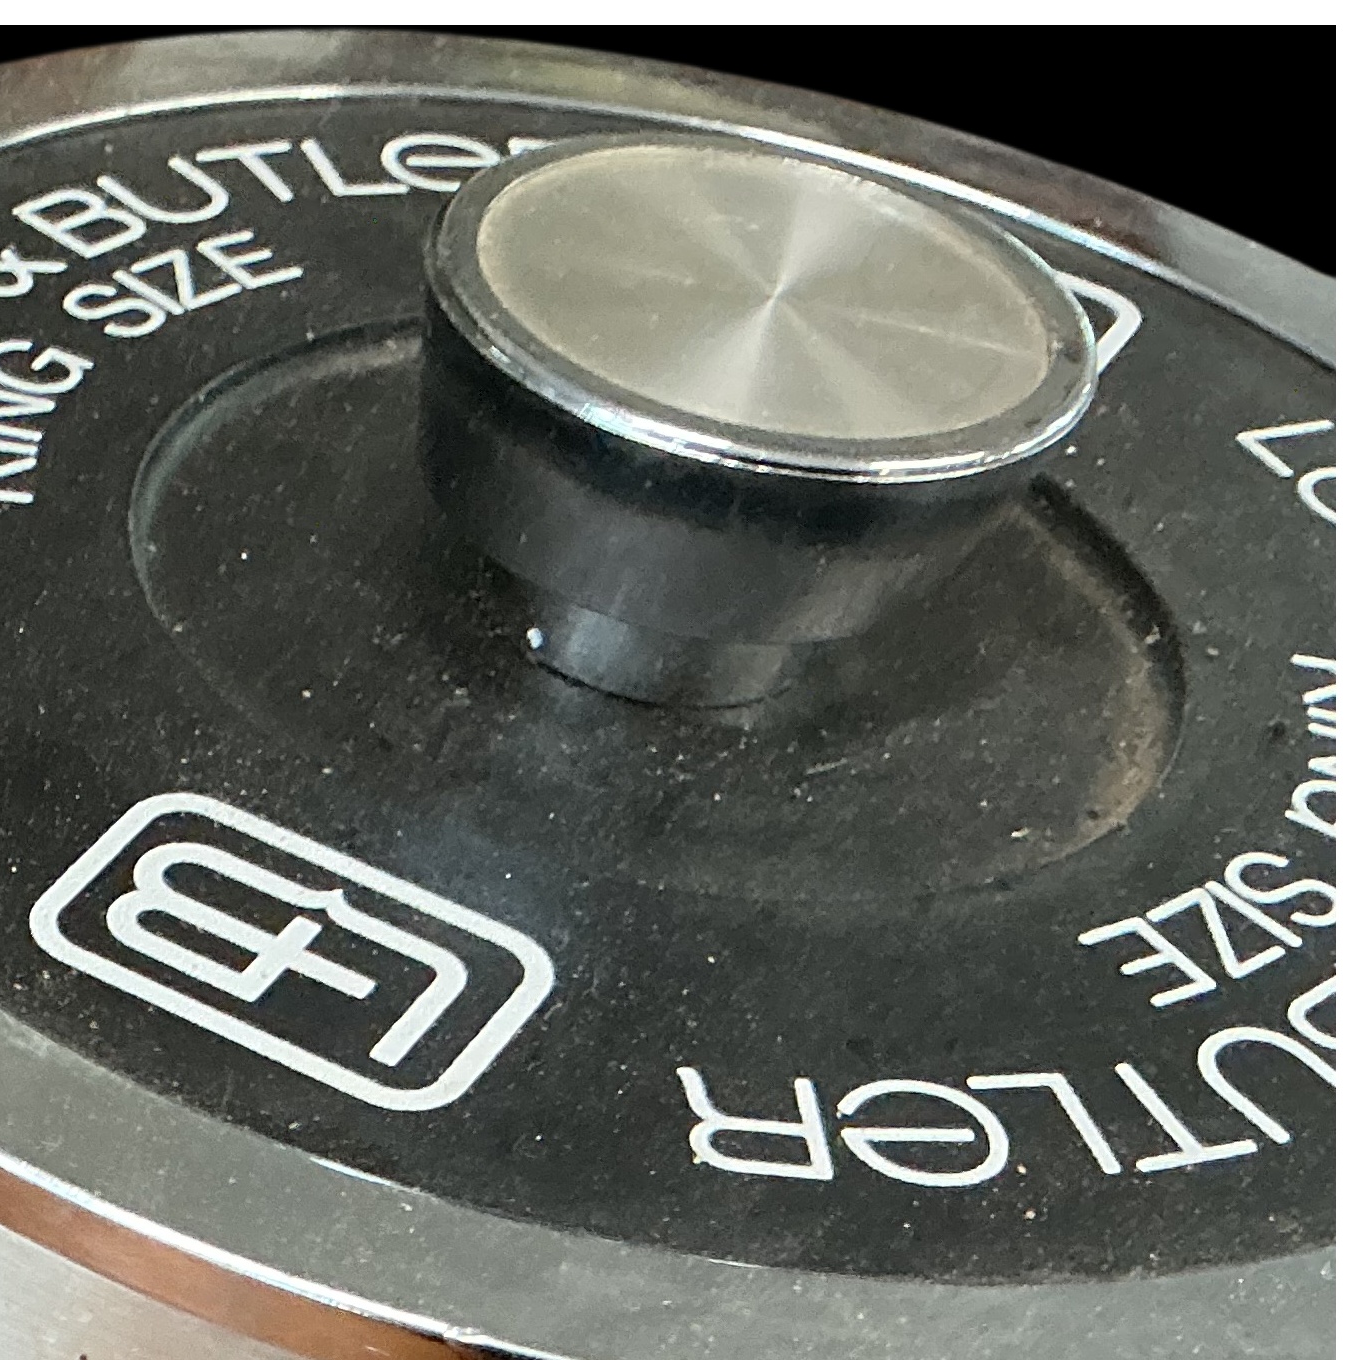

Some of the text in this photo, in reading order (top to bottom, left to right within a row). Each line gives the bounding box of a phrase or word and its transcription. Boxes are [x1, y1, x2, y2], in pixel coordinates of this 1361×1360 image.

[12, 133, 555, 260] BUTLe
[63, 230, 304, 338] SIZE
[1078, 851, 1336, 1007] SIZE
